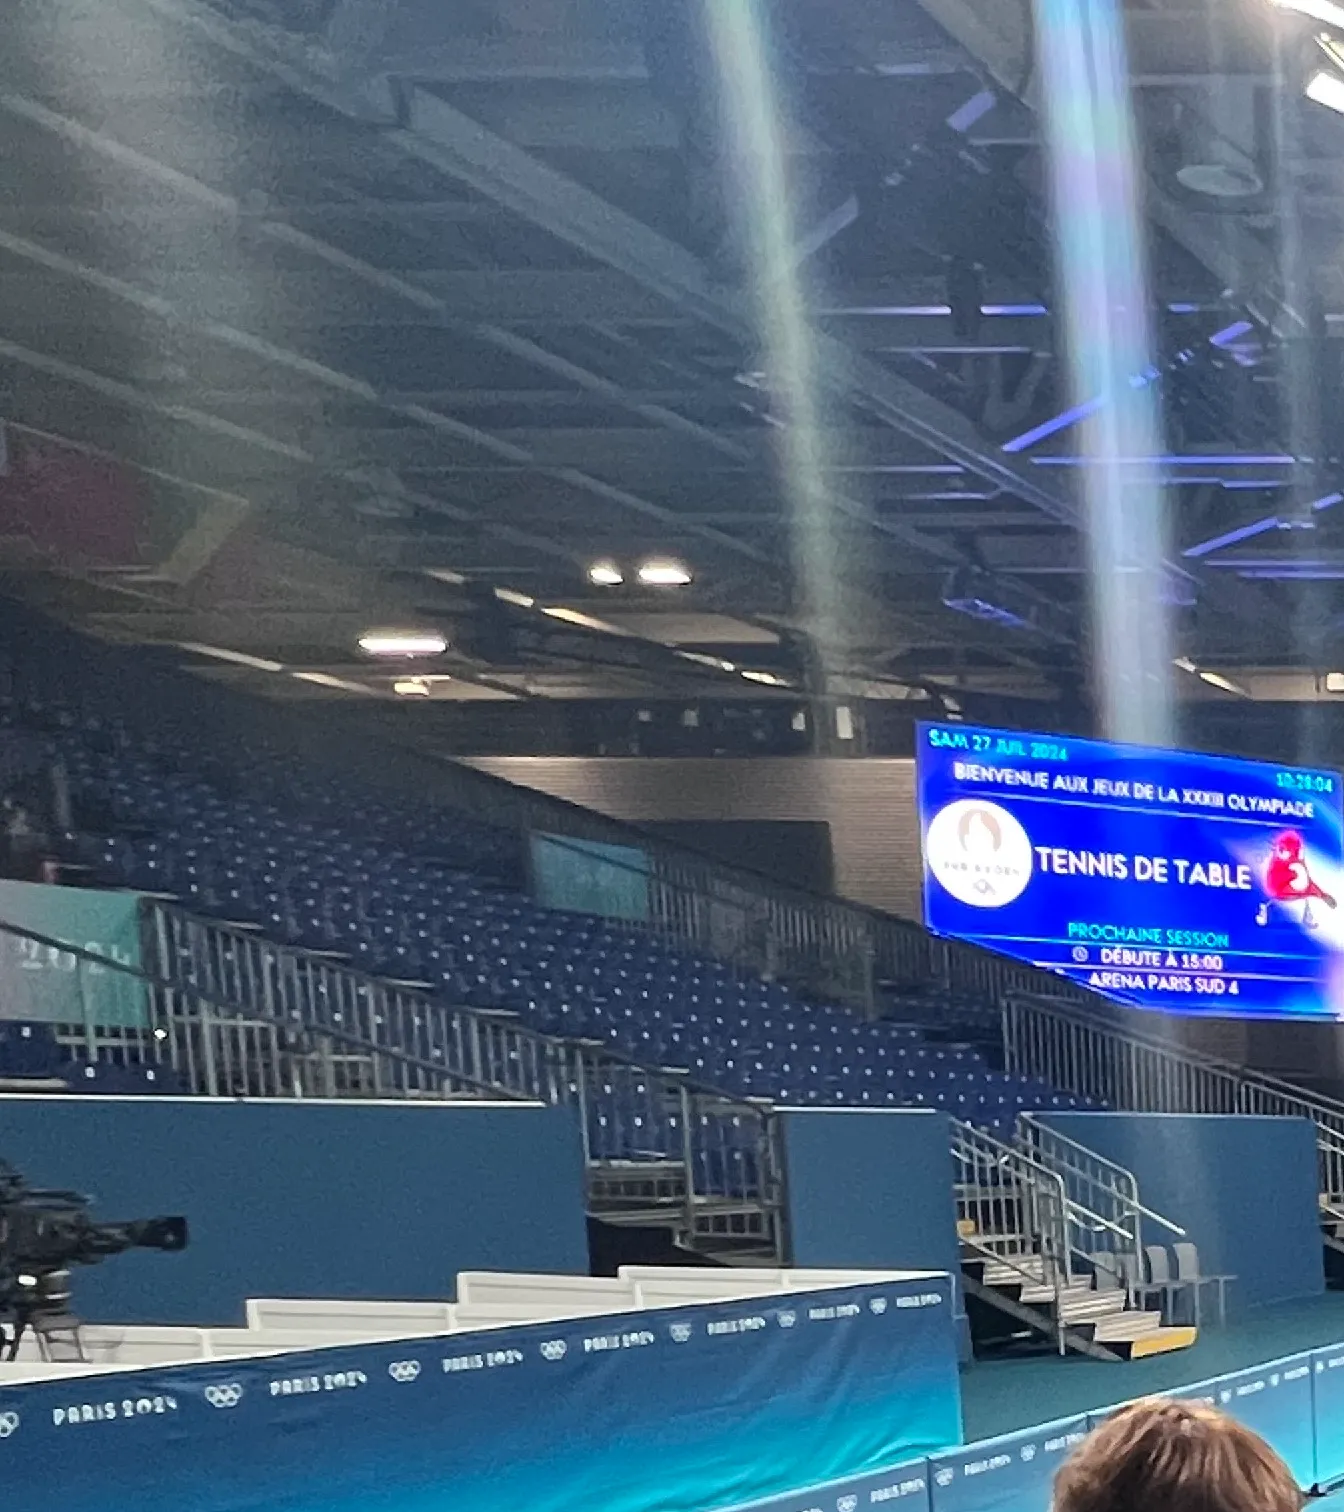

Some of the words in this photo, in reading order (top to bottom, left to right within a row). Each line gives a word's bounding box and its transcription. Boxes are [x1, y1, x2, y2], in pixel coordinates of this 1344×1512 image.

[928, 729, 969, 750] SAM
[972, 735, 992, 751] 27
[1030, 742, 1069, 761] 2024
[952, 761, 1050, 790] BIENVENUE
[1053, 775, 1090, 794] AUX
[1091, 778, 1131, 797] JEUX
[1133, 781, 1154, 801] DE
[1158, 786, 1180, 804] LA
[1227, 794, 1315, 818] OLYMPIADE
[1034, 846, 1130, 881] TENNIS
[1134, 854, 1168, 884] DE
[1173, 858, 1253, 891] TABLE
[1068, 922, 1162, 944] PROCHAINE
[1166, 929, 1230, 948] SESSION
[1100, 945, 1162, 967] DÉBUTE
[1164, 948, 1179, 968] À
[1182, 953, 1224, 971] 15:00
[1088, 971, 1146, 990] ARENA
[1149, 974, 1192, 992] PARIS
[1194, 978, 1226, 995] SUD
[1228, 980, 1240, 995] 4
